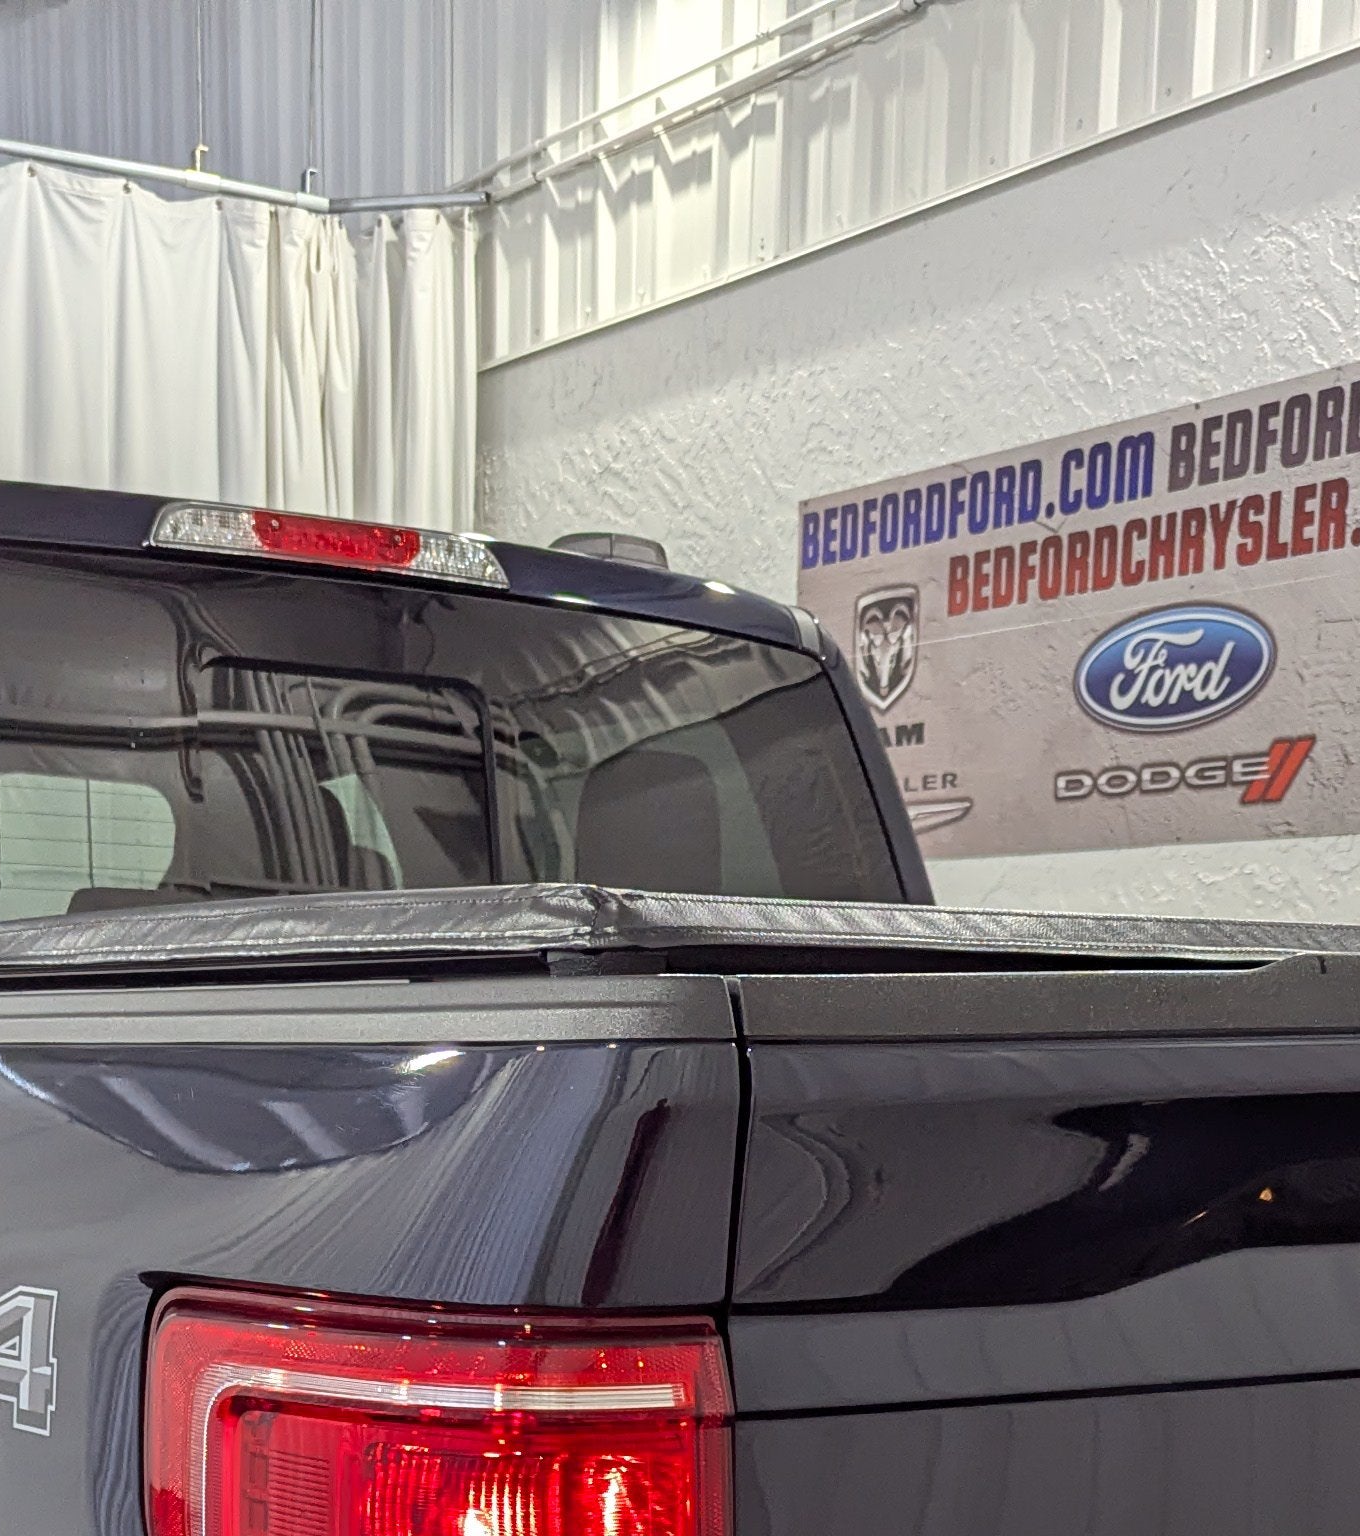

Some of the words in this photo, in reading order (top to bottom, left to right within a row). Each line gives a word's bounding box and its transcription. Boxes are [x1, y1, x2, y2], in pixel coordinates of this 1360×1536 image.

[801, 431, 1154, 570] BEDFORDFORD.COM
[1109, 627, 1236, 711] Ford
[1055, 752, 1272, 801] DODGE
